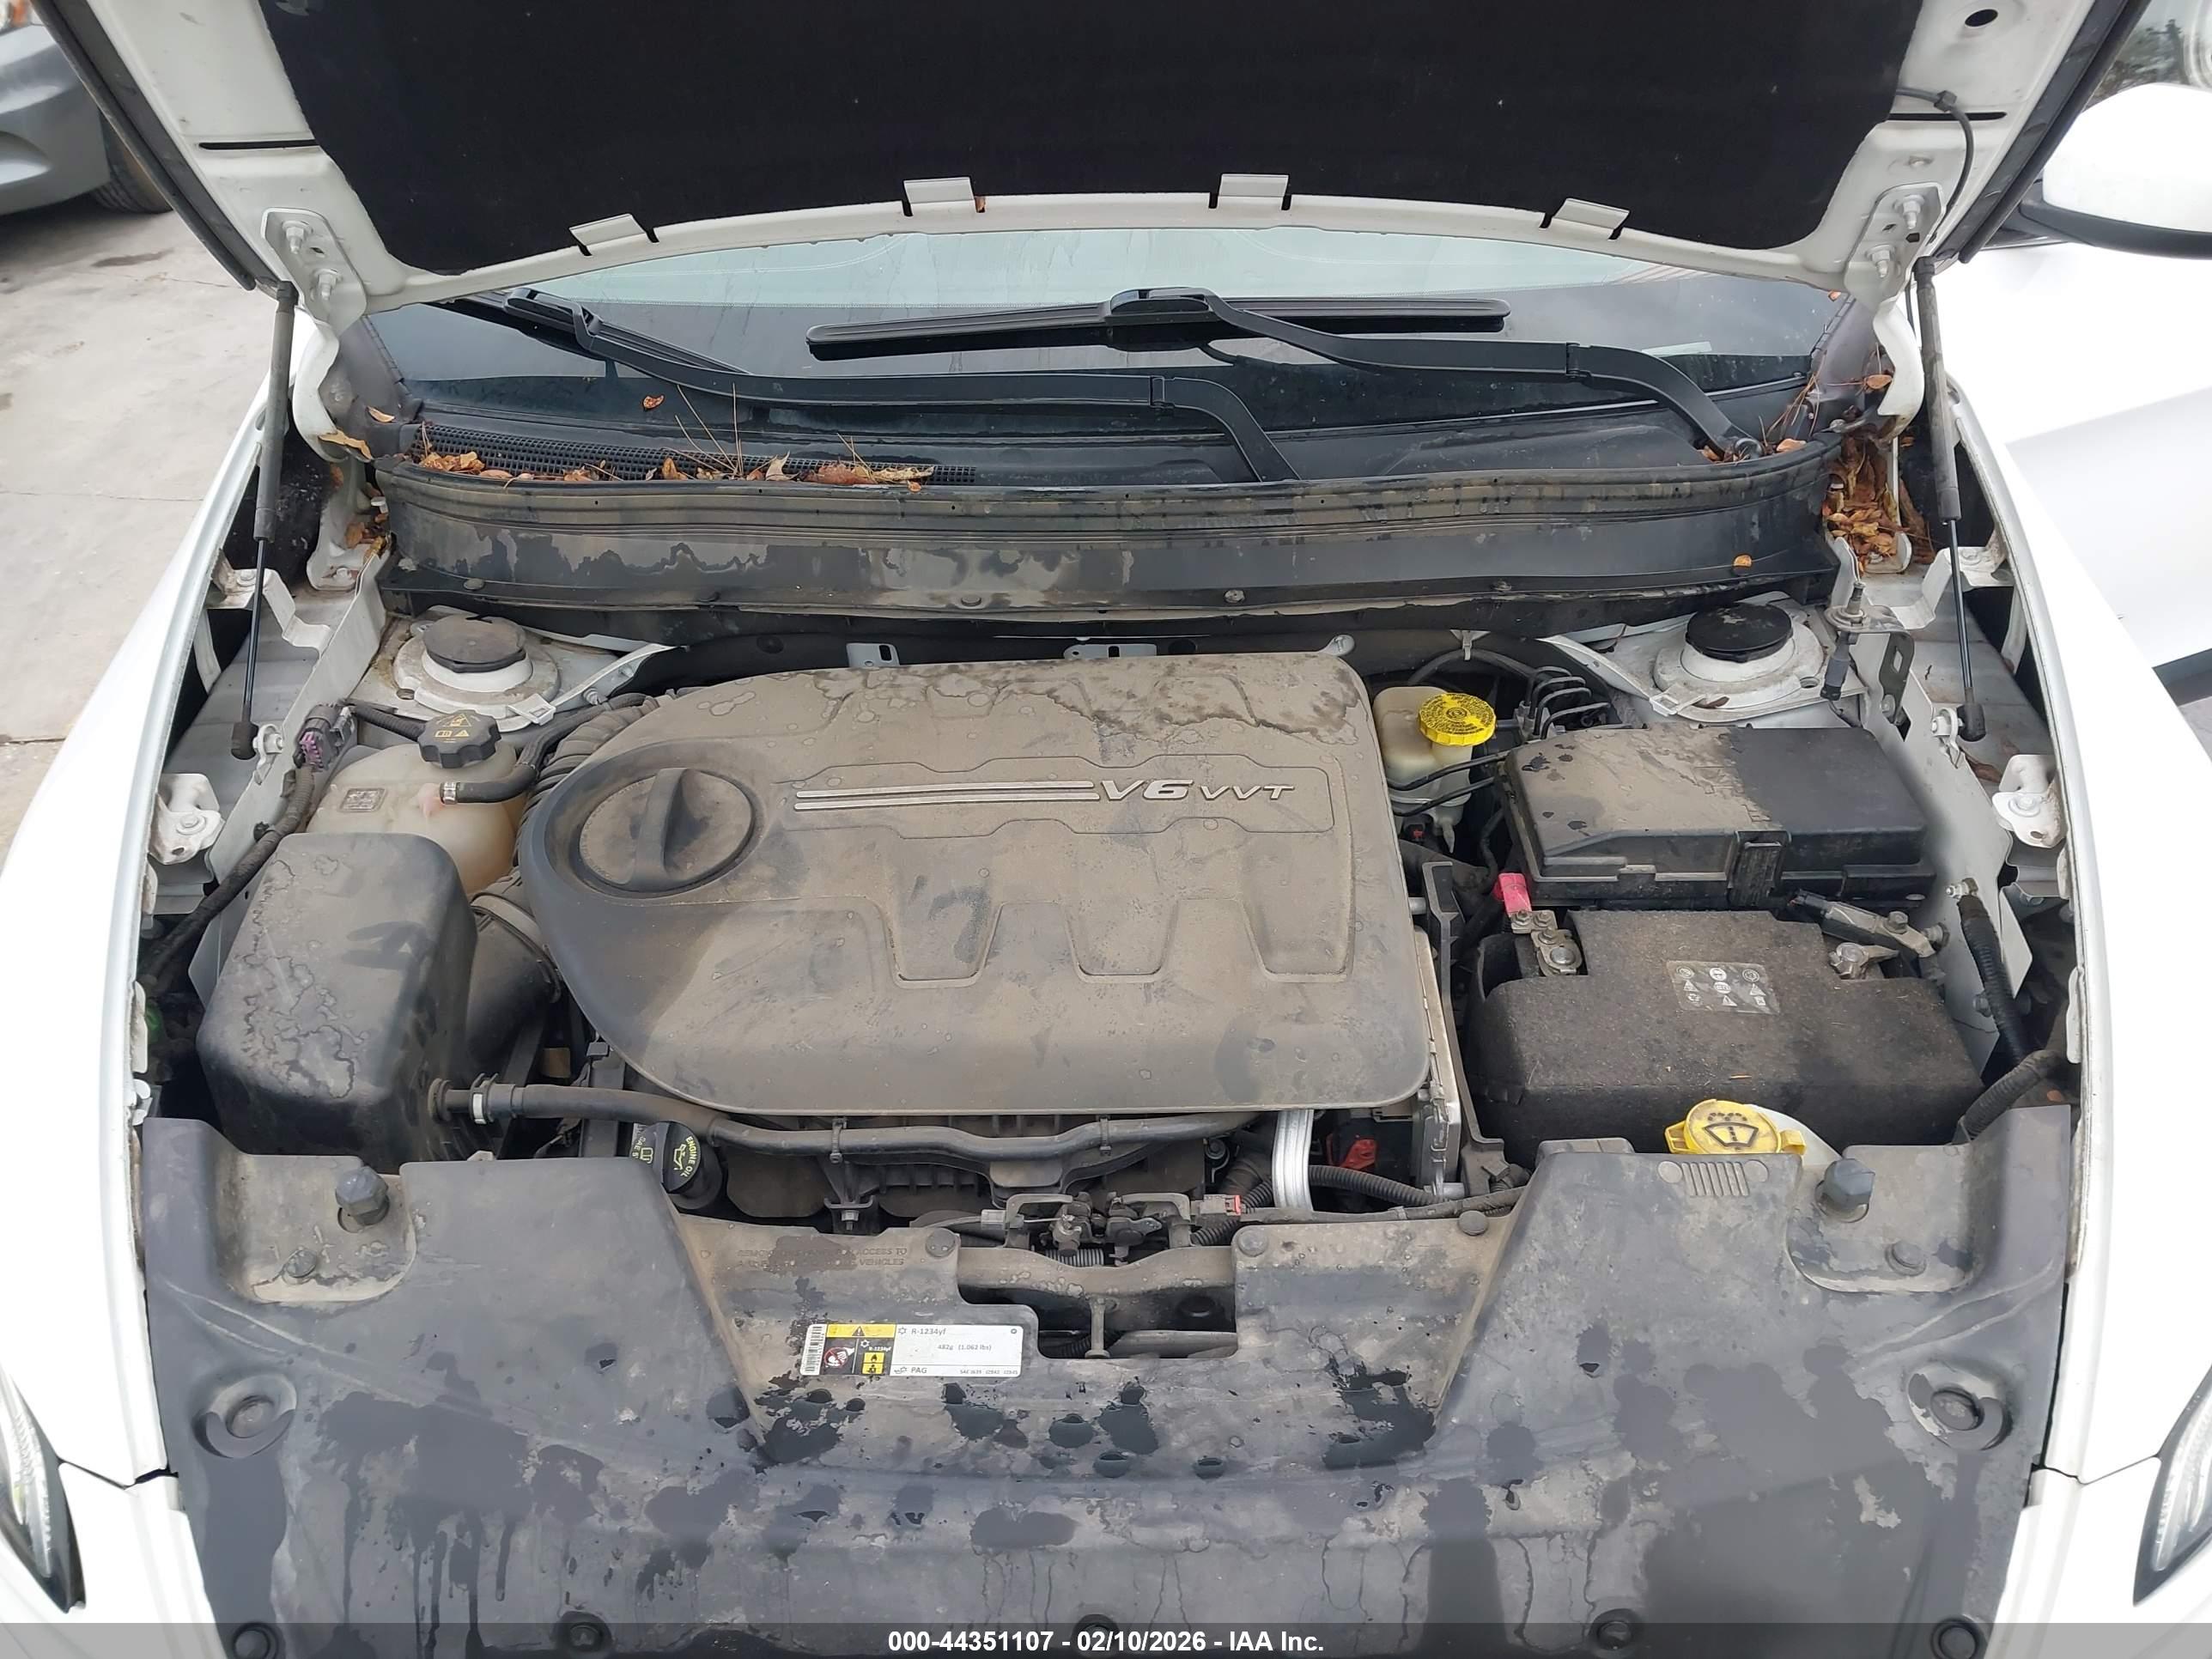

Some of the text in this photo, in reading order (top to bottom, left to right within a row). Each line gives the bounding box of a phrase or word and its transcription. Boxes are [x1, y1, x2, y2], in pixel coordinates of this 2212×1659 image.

[1101, 780, 1295, 801] V6 VVT
[680, 1136, 697, 1177] ENGINE OIL
[911, 1328, 947, 1336] R-1234yf
